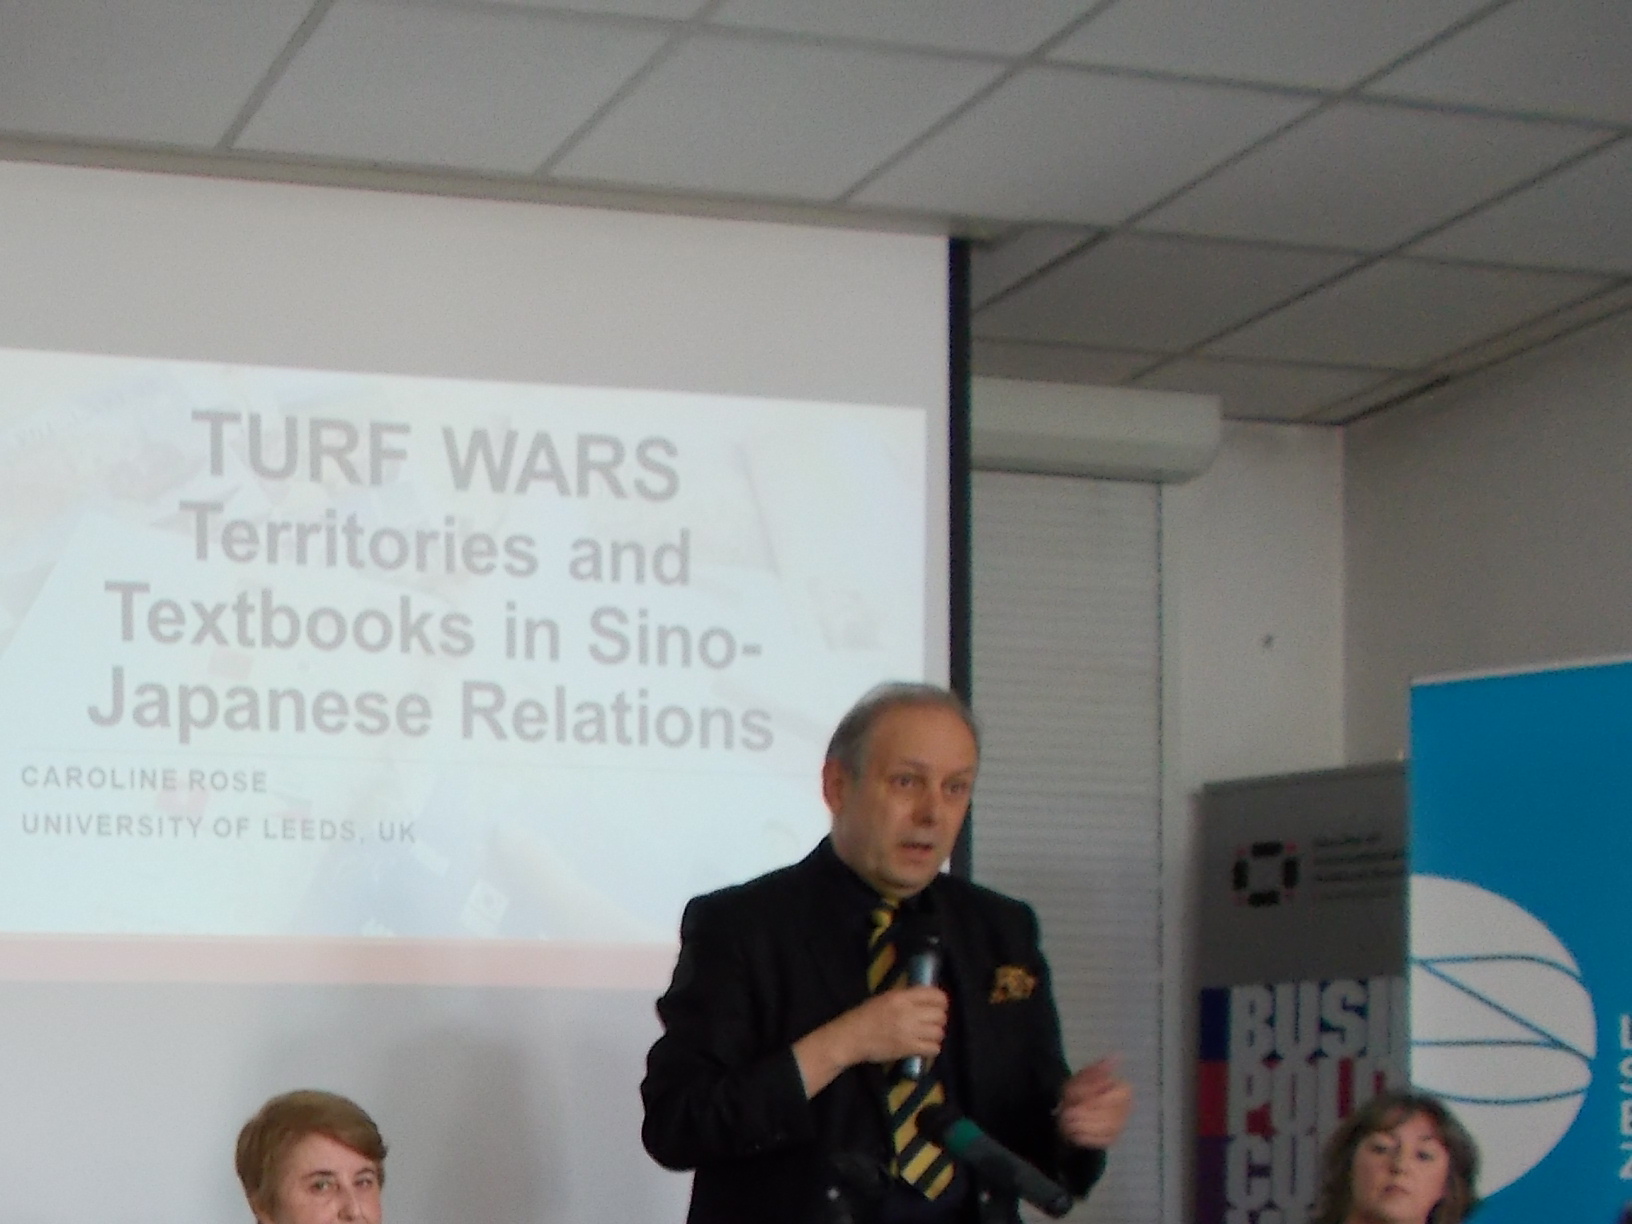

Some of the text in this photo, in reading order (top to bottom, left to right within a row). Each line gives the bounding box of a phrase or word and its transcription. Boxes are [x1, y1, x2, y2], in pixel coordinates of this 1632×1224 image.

[191, 409, 680, 502] TURF WARS
[179, 501, 691, 587] Territories and
[104, 582, 762, 669] Textbooks in Sino-
[88, 666, 774, 751] Japanese Relations
[21, 766, 267, 793] CAROLINE ROSE
[21, 813, 201, 838] UNIVERSITY
[212, 816, 249, 838] OF
[378, 820, 415, 844] UK
